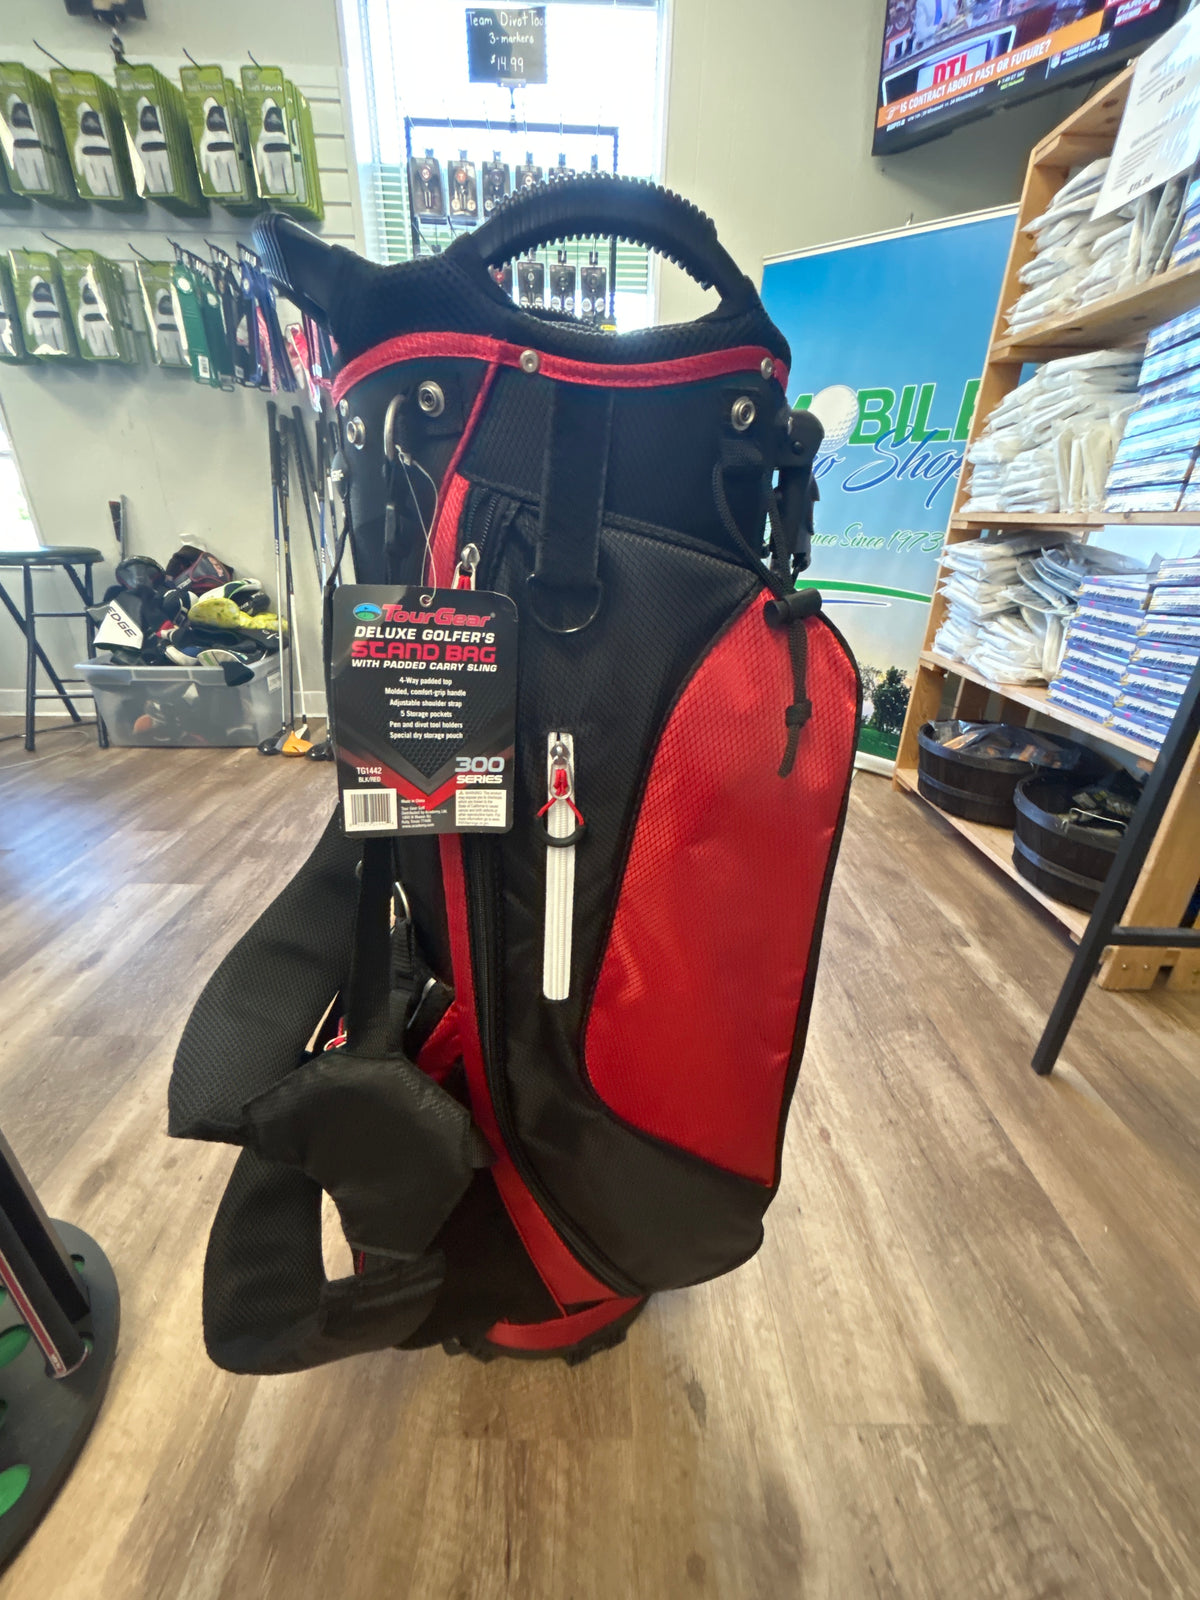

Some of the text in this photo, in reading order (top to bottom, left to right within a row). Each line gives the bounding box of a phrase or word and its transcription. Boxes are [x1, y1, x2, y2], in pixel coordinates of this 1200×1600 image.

[467, 11, 493, 26] Team
[500, 10, 528, 27] Divot
[489, 32, 534, 44] 3-markers
[490, 54, 524, 73] $14.99
[900, 102, 907, 114] IS
[909, 84, 946, 110] CONTRACT
[947, 73, 974, 94] ABOUT
[974, 62, 996, 86] PAST
[996, 57, 1010, 73] OR
[1010, 39, 1052, 67] FUTURE?
[840, 522, 885, 549] Since
[886, 530, 945, 554] 1973
[354, 625, 496, 644] DELUXE GOLFER'S
[351, 640, 496, 663] STAND BAG
[351, 658, 498, 673] WITH PADDED CARRY SLING
[399, 676, 419, 685] 4-Way
[442, 678, 453, 686] top
[410, 688, 446, 697] comfort-grip
[447, 688, 467, 697] handle
[389, 699, 420, 707] Adjustable
[406, 710, 429, 718] Storage
[389, 731, 464, 740] Special dry storage pouch
[356, 766, 383, 775] TG1442
[454, 756, 505, 773] 300
[456, 774, 503, 784] SERIES
